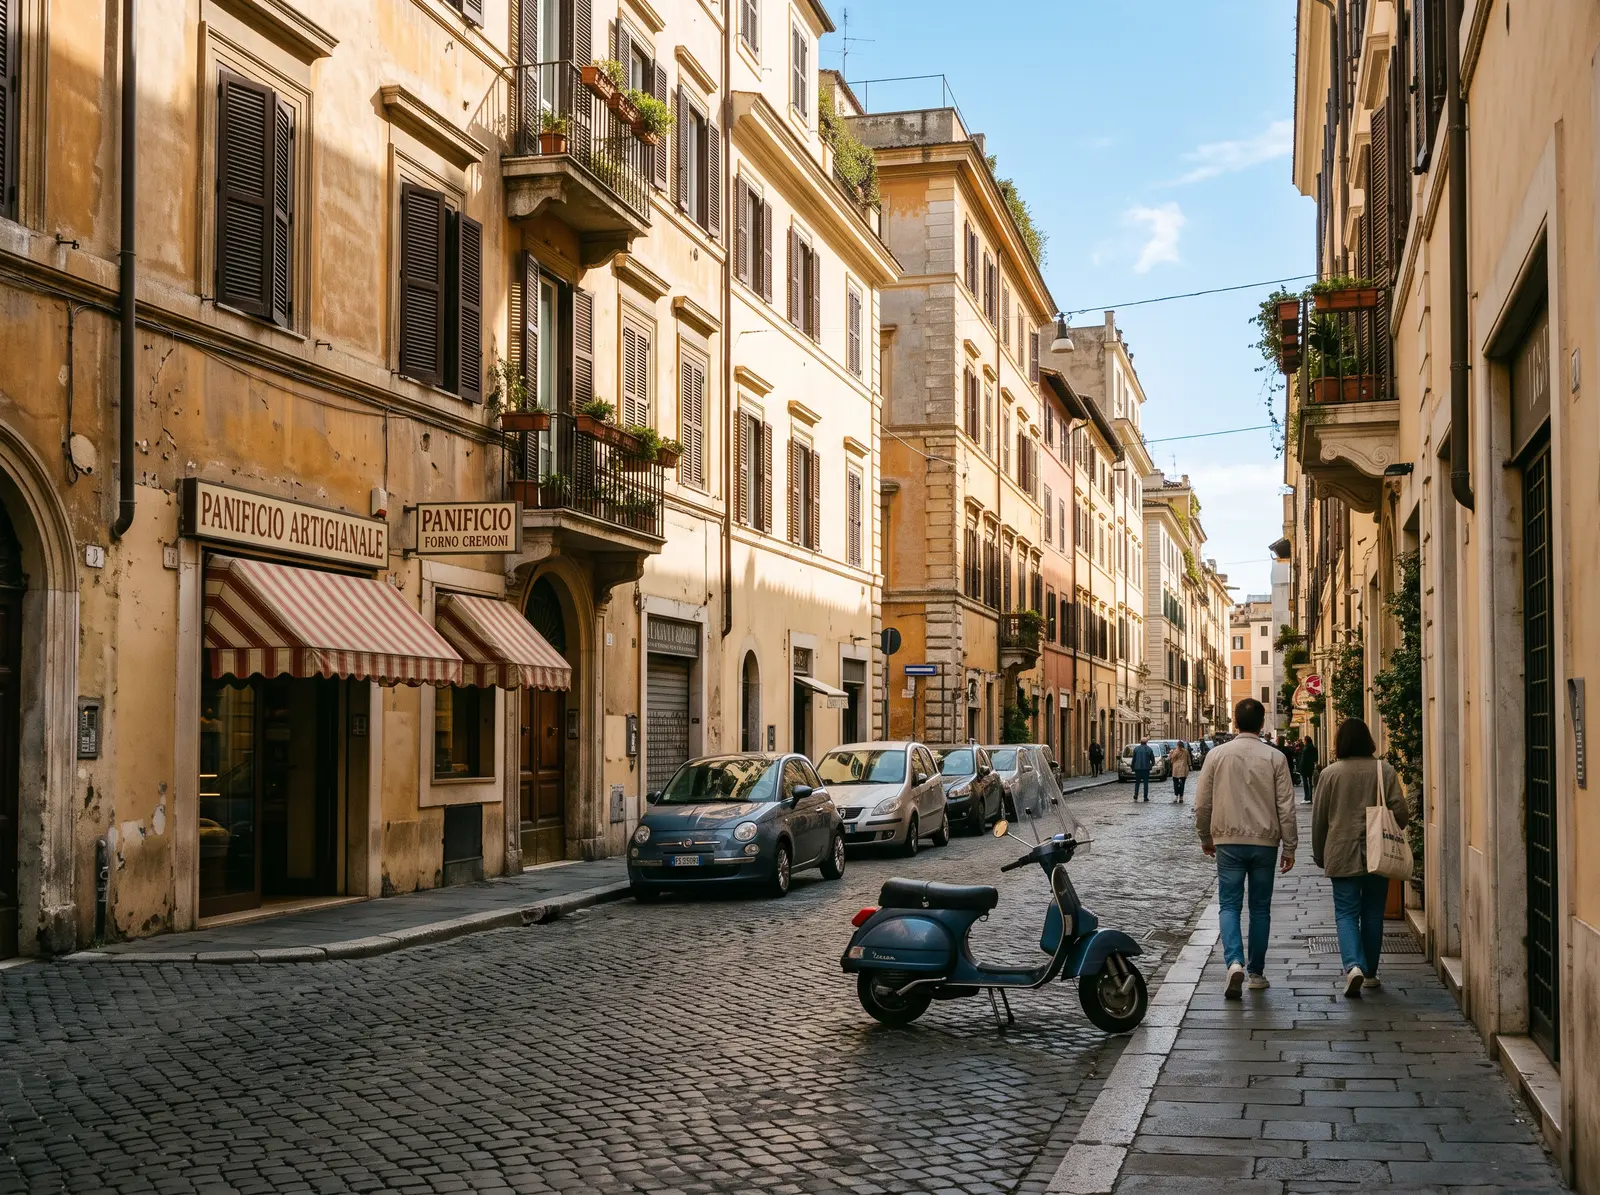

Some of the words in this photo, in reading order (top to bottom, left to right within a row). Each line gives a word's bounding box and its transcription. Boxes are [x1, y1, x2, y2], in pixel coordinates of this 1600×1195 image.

[201, 491, 284, 540] PANIFICIO
[289, 511, 384, 560] ARTIGIANALE
[422, 507, 512, 532] PANIFICIO
[425, 536, 459, 548] FORNO
[462, 535, 509, 547] CREMONI
